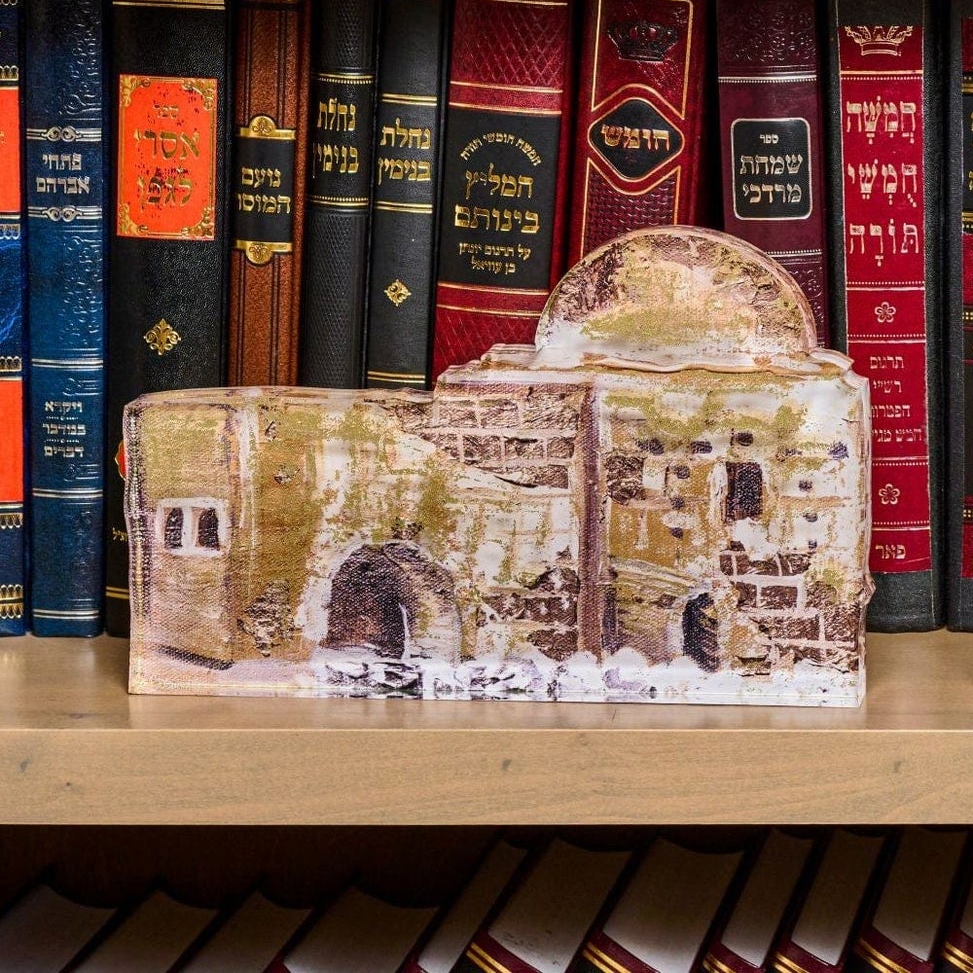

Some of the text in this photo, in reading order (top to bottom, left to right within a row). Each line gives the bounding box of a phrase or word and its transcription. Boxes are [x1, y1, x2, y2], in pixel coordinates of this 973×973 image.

[317, 98, 357, 132] נחלת
[380, 117, 431, 150] נחלת
[601, 124, 670, 151] חומש
[759, 133, 779, 144] ספר
[134, 130, 200, 160] אסרי
[460, 131, 542, 167] חמשה חומשי תורה
[42, 152, 82, 171] פתחי
[312, 143, 360, 178] בנימין
[378, 157, 431, 185] בנימין
[740, 154, 803, 175] שמחת
[35, 176, 90, 195] אברהם
[241, 168, 281, 189] נועם
[465, 162, 534, 200] המליץ
[742, 183, 802, 204] מרדכי
[454, 203, 541, 234] בינותם
[517, 244, 532, 261] על
[504, 262, 516, 276] בן
[869, 355, 905, 369] תרגום
[44, 401, 83, 414] ויקרא
[42, 422, 86, 436] במדבר
[44, 445, 84, 457] דברים
[875, 543, 906, 560] פאר
